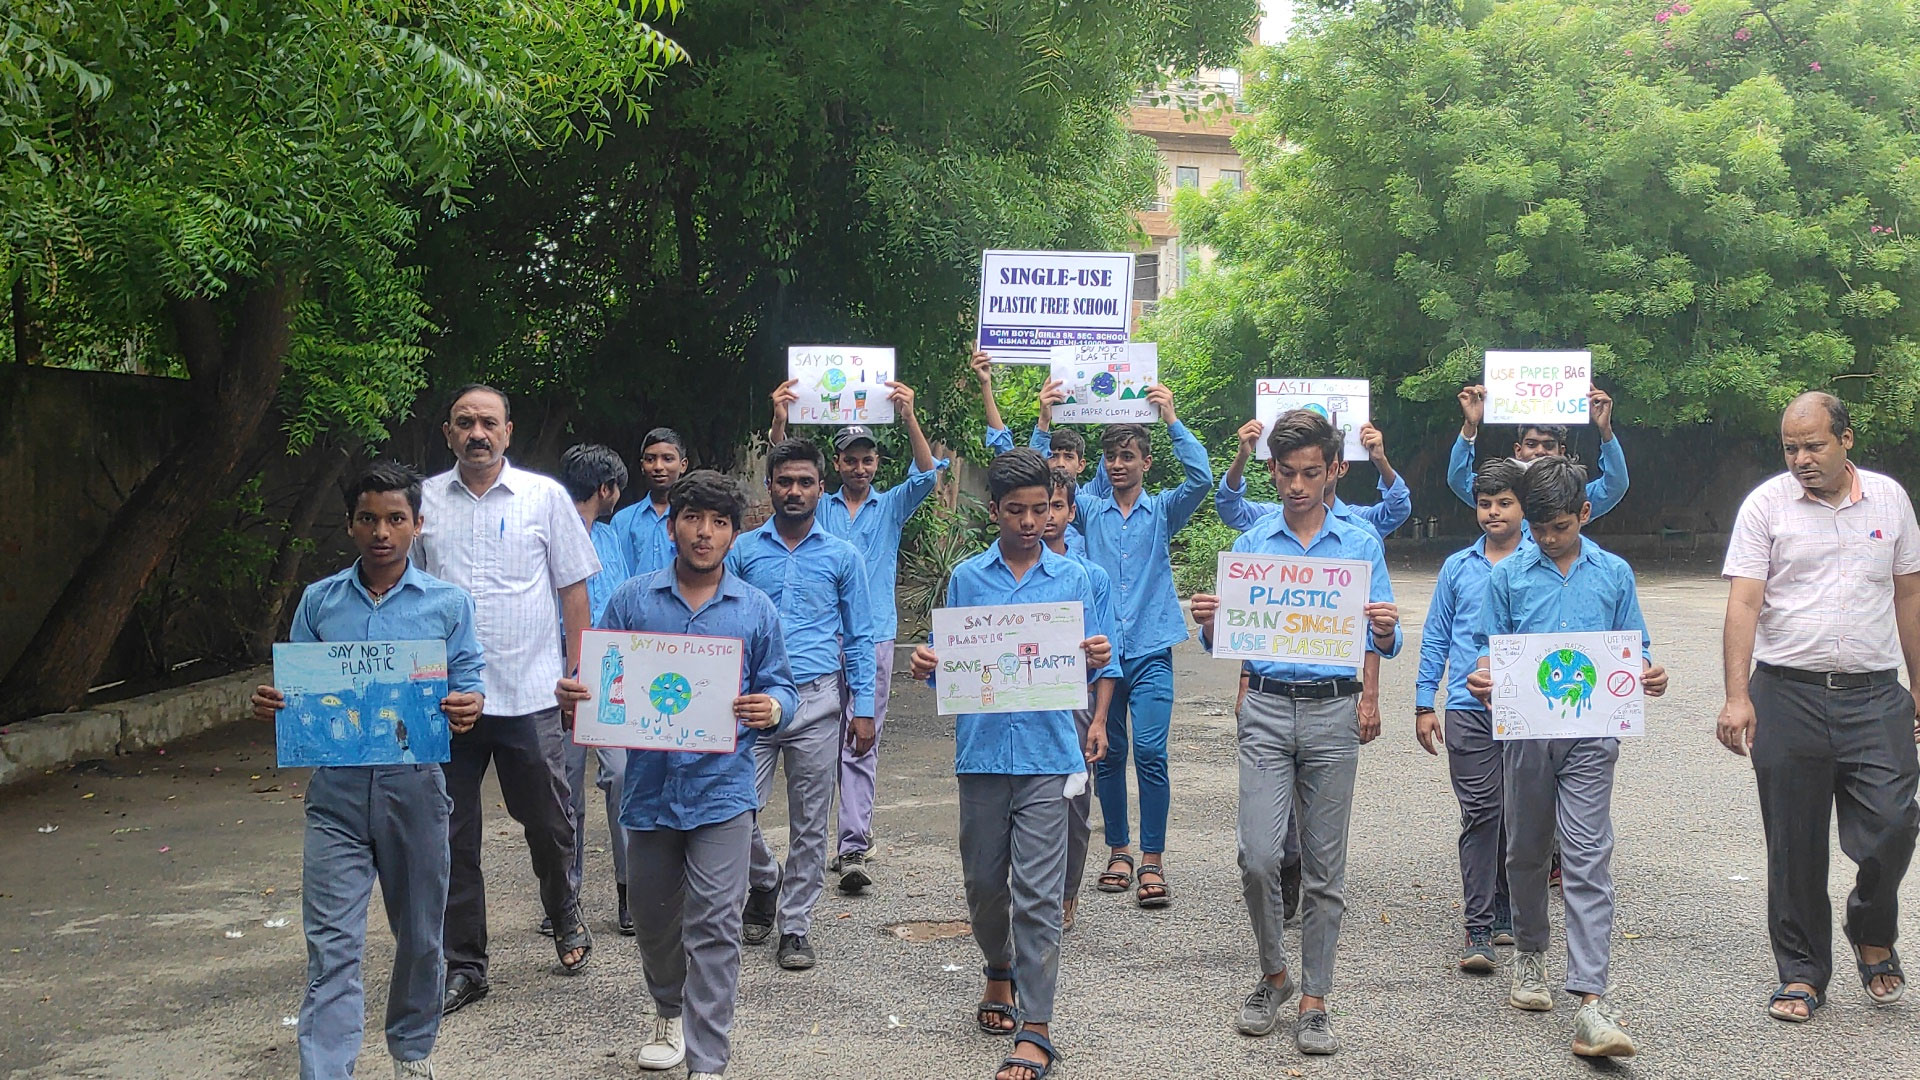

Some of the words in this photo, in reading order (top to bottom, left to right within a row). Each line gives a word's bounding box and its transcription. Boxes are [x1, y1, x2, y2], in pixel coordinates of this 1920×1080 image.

[1000, 268, 1112, 286] SINGLE-USE
[989, 296, 1037, 314] PLASTIC
[1040, 297, 1069, 314] FREE
[1073, 298, 1118, 315] SCHOOL
[795, 353, 821, 366] SAY
[825, 354, 843, 366] NO
[850, 356, 863, 366] TO
[1490, 368, 1515, 380] USE
[1520, 366, 1559, 380] PAPER
[1564, 366, 1585, 379] BAG
[1516, 382, 1563, 398] STOP
[800, 407, 868, 420] PLASTIC
[1557, 398, 1587, 413] USE
[1228, 562, 1275, 581] SAY
[1280, 565, 1314, 584] NO
[1323, 567, 1352, 587] TO
[1250, 586, 1341, 609] PLASTIC
[964, 614, 993, 629] SAY
[997, 614, 1024, 626] NO
[1031, 613, 1051, 621] TO
[1227, 609, 1282, 629] BAN
[1283, 613, 1356, 635] SINGLE
[631, 634, 654, 651] SAY
[656, 641, 678, 654] NO
[684, 642, 732, 656] PLASTIC
[948, 633, 1002, 646] PLASTIC
[1230, 631, 1266, 650] USE
[1272, 635, 1354, 657] PLASTIC
[328, 644, 355, 658] SAY
[361, 645, 379, 657] NO
[342, 657, 394, 676] PLASTIC
[944, 660, 981, 673] SAVE
[1034, 655, 1076, 669] EARTH
